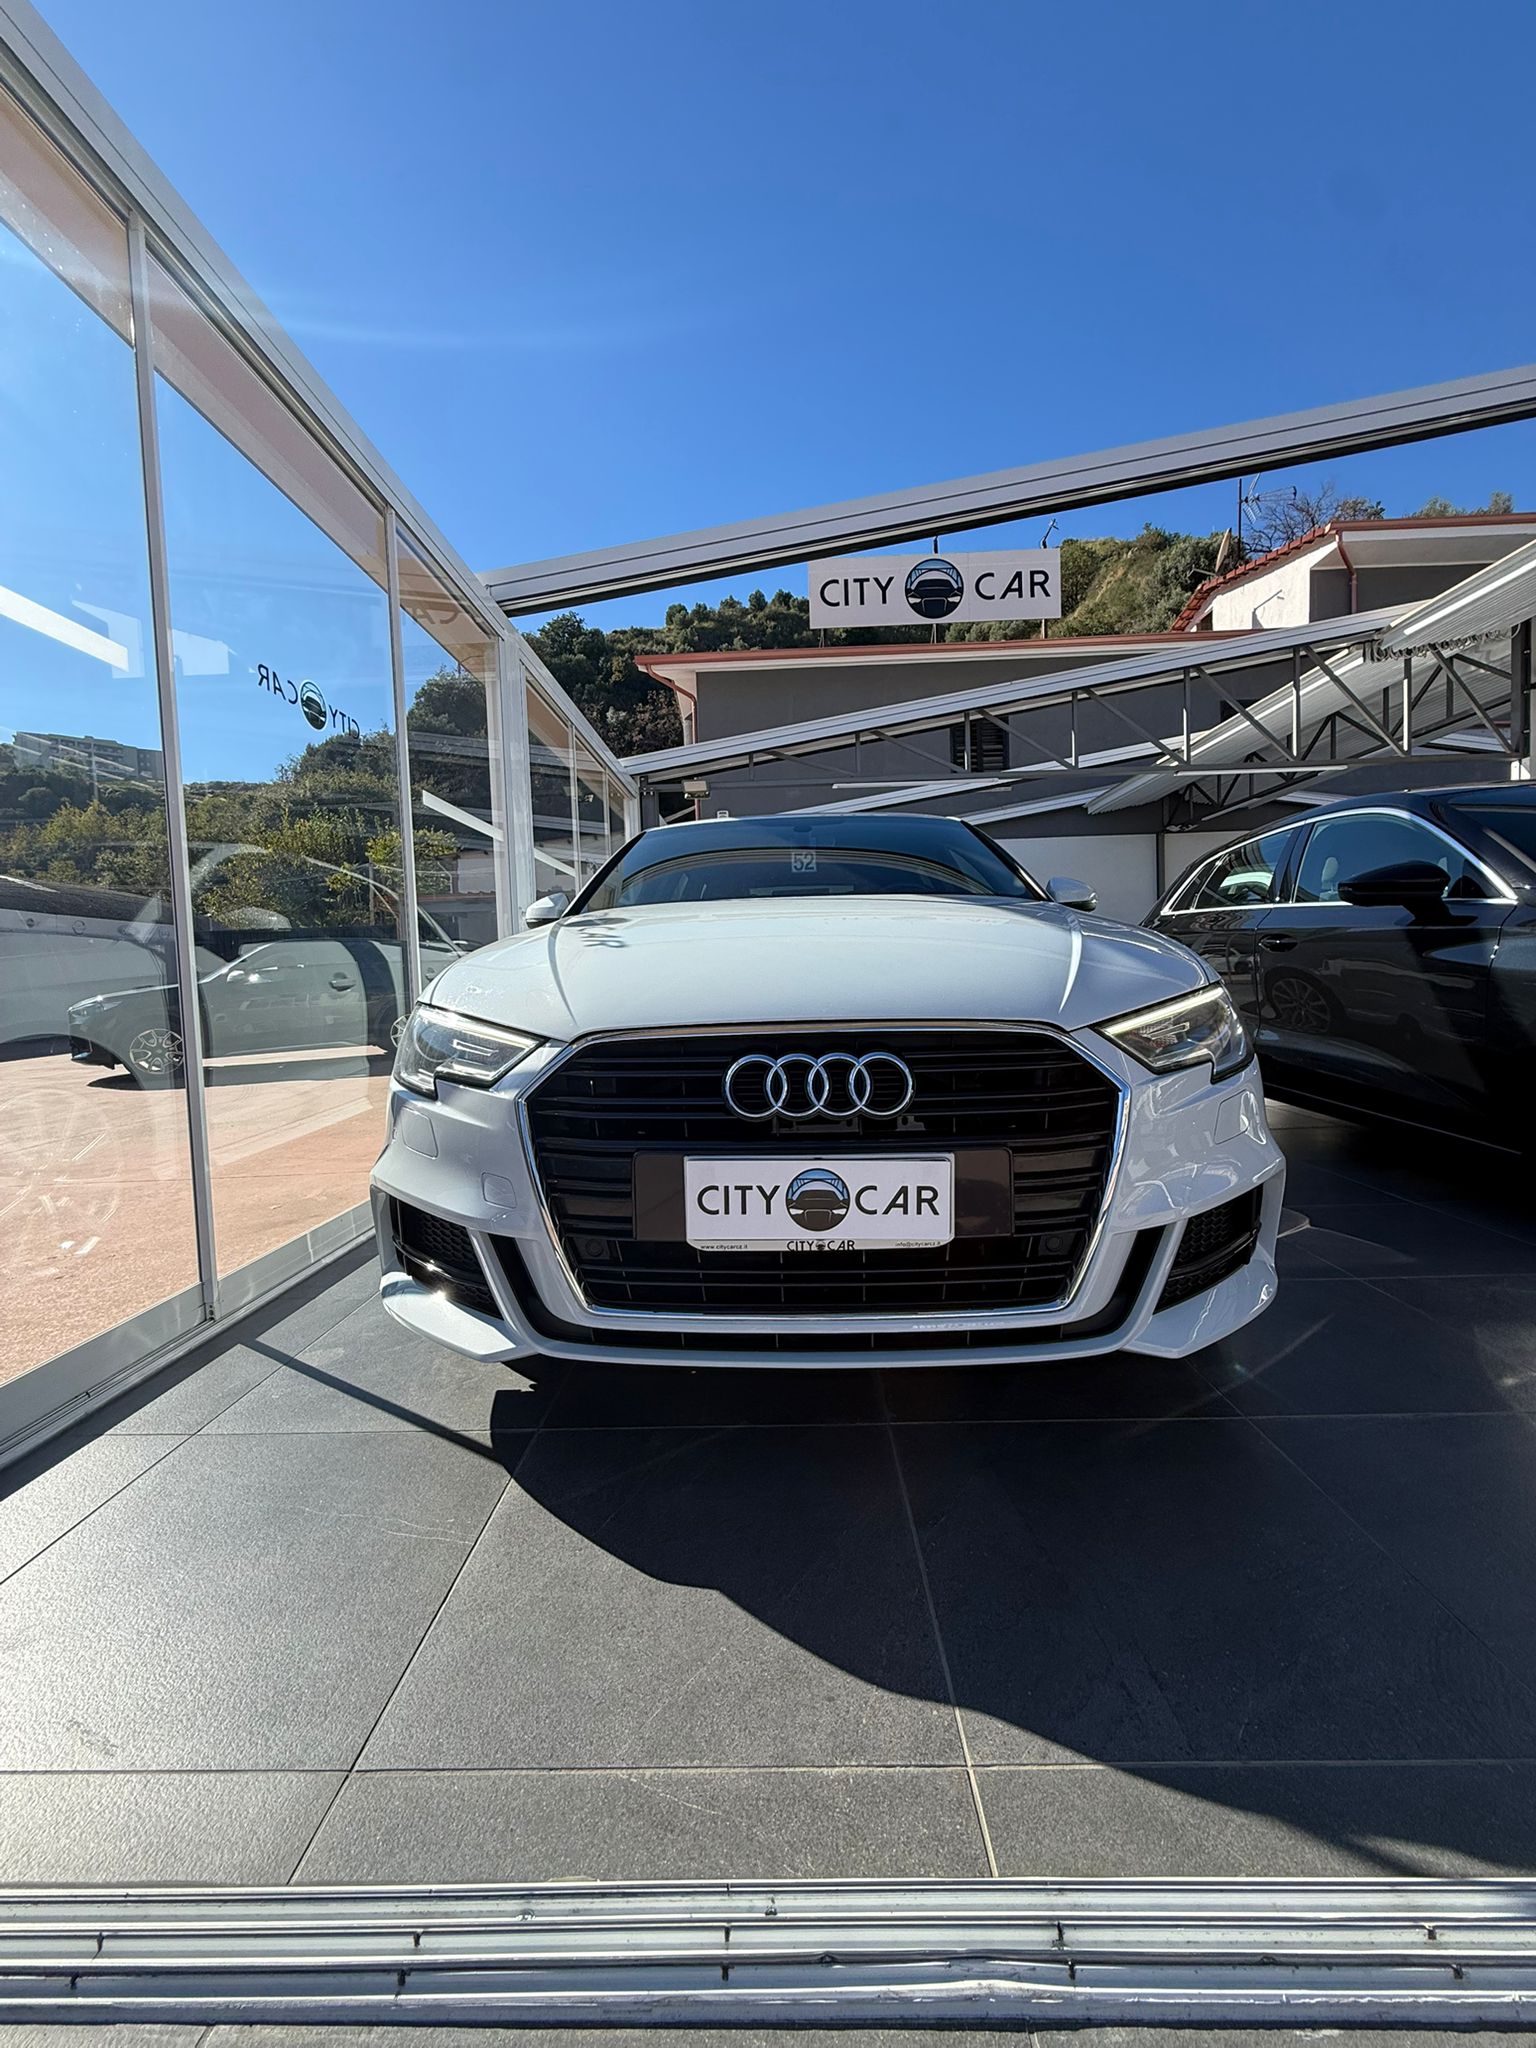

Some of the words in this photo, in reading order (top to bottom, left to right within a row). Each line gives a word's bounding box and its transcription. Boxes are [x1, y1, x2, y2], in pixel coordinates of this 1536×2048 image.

[819, 576, 895, 607] CITY
[974, 570, 1052, 600] CAR
[793, 853, 814, 870] 52
[697, 1185, 780, 1216] CITY
[855, 1185, 939, 1216] CAR
[786, 1240, 815, 1252] CITY
[827, 1240, 856, 1252] CAR
